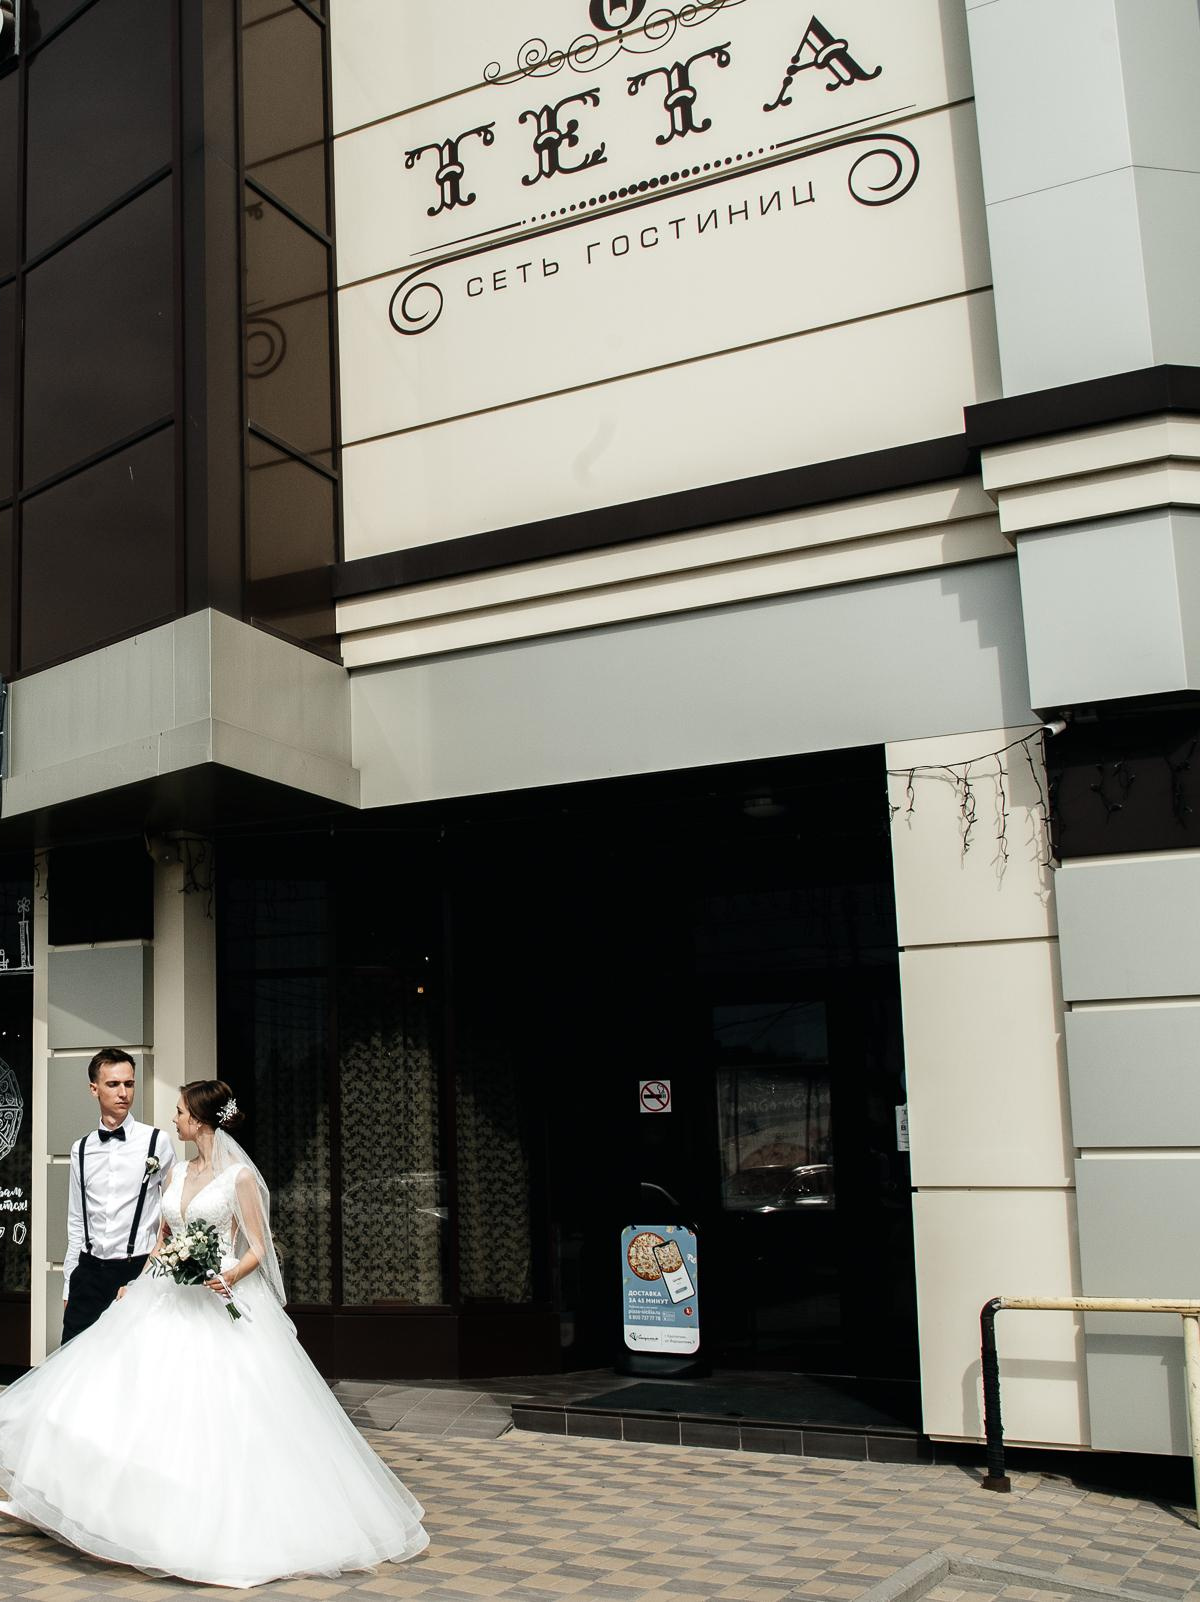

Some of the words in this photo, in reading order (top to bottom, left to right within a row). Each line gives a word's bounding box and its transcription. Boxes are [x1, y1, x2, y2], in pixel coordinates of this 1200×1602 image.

[404, 14, 882, 217] ТЕТА
[466, 257, 561, 298] СЕТЬ
[585, 180, 817, 265] ГОСТИНИЦ
